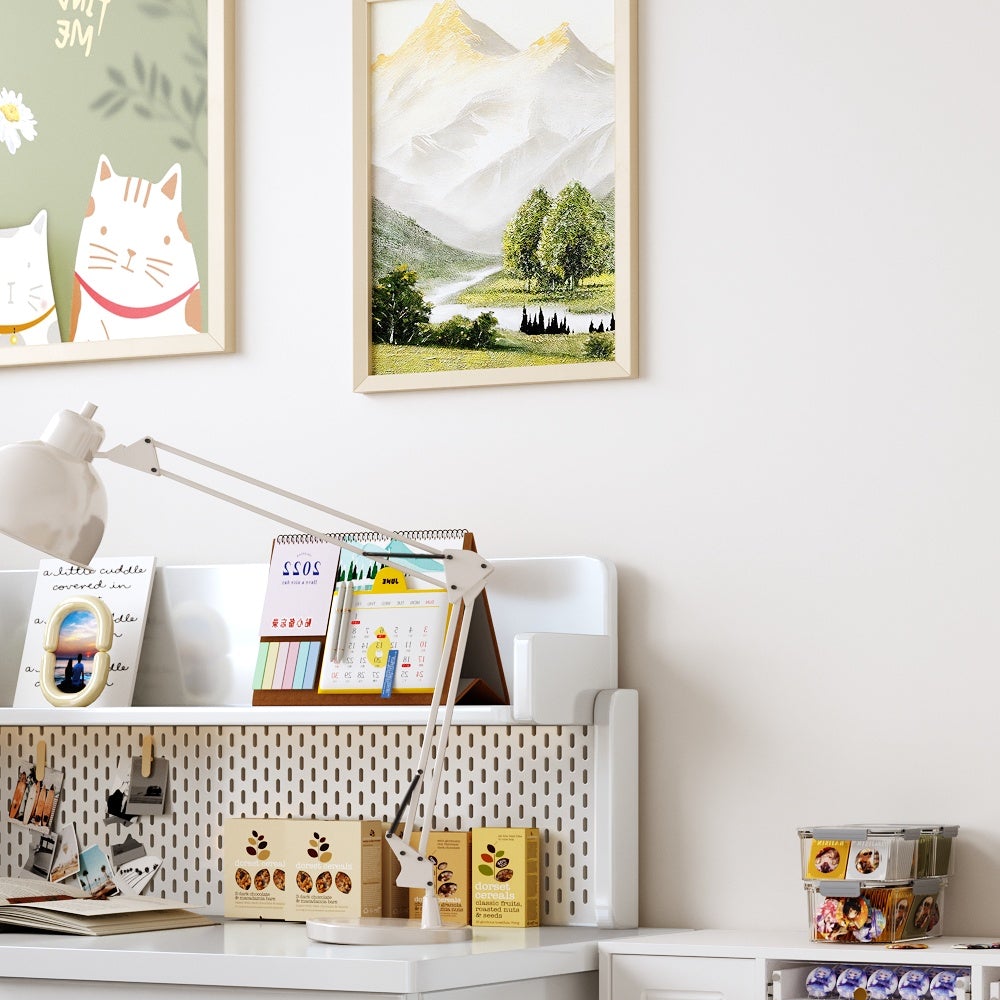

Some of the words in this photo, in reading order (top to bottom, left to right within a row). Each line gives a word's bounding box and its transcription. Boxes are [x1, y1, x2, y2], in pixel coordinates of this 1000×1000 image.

[100, 564, 147, 575] cuddle
[52, 580, 107, 591] covered
[109, 582, 131, 590] in
[321, 863, 353, 871] cereals
[475, 882, 510, 891] dorset
[475, 891, 515, 900] cereals
